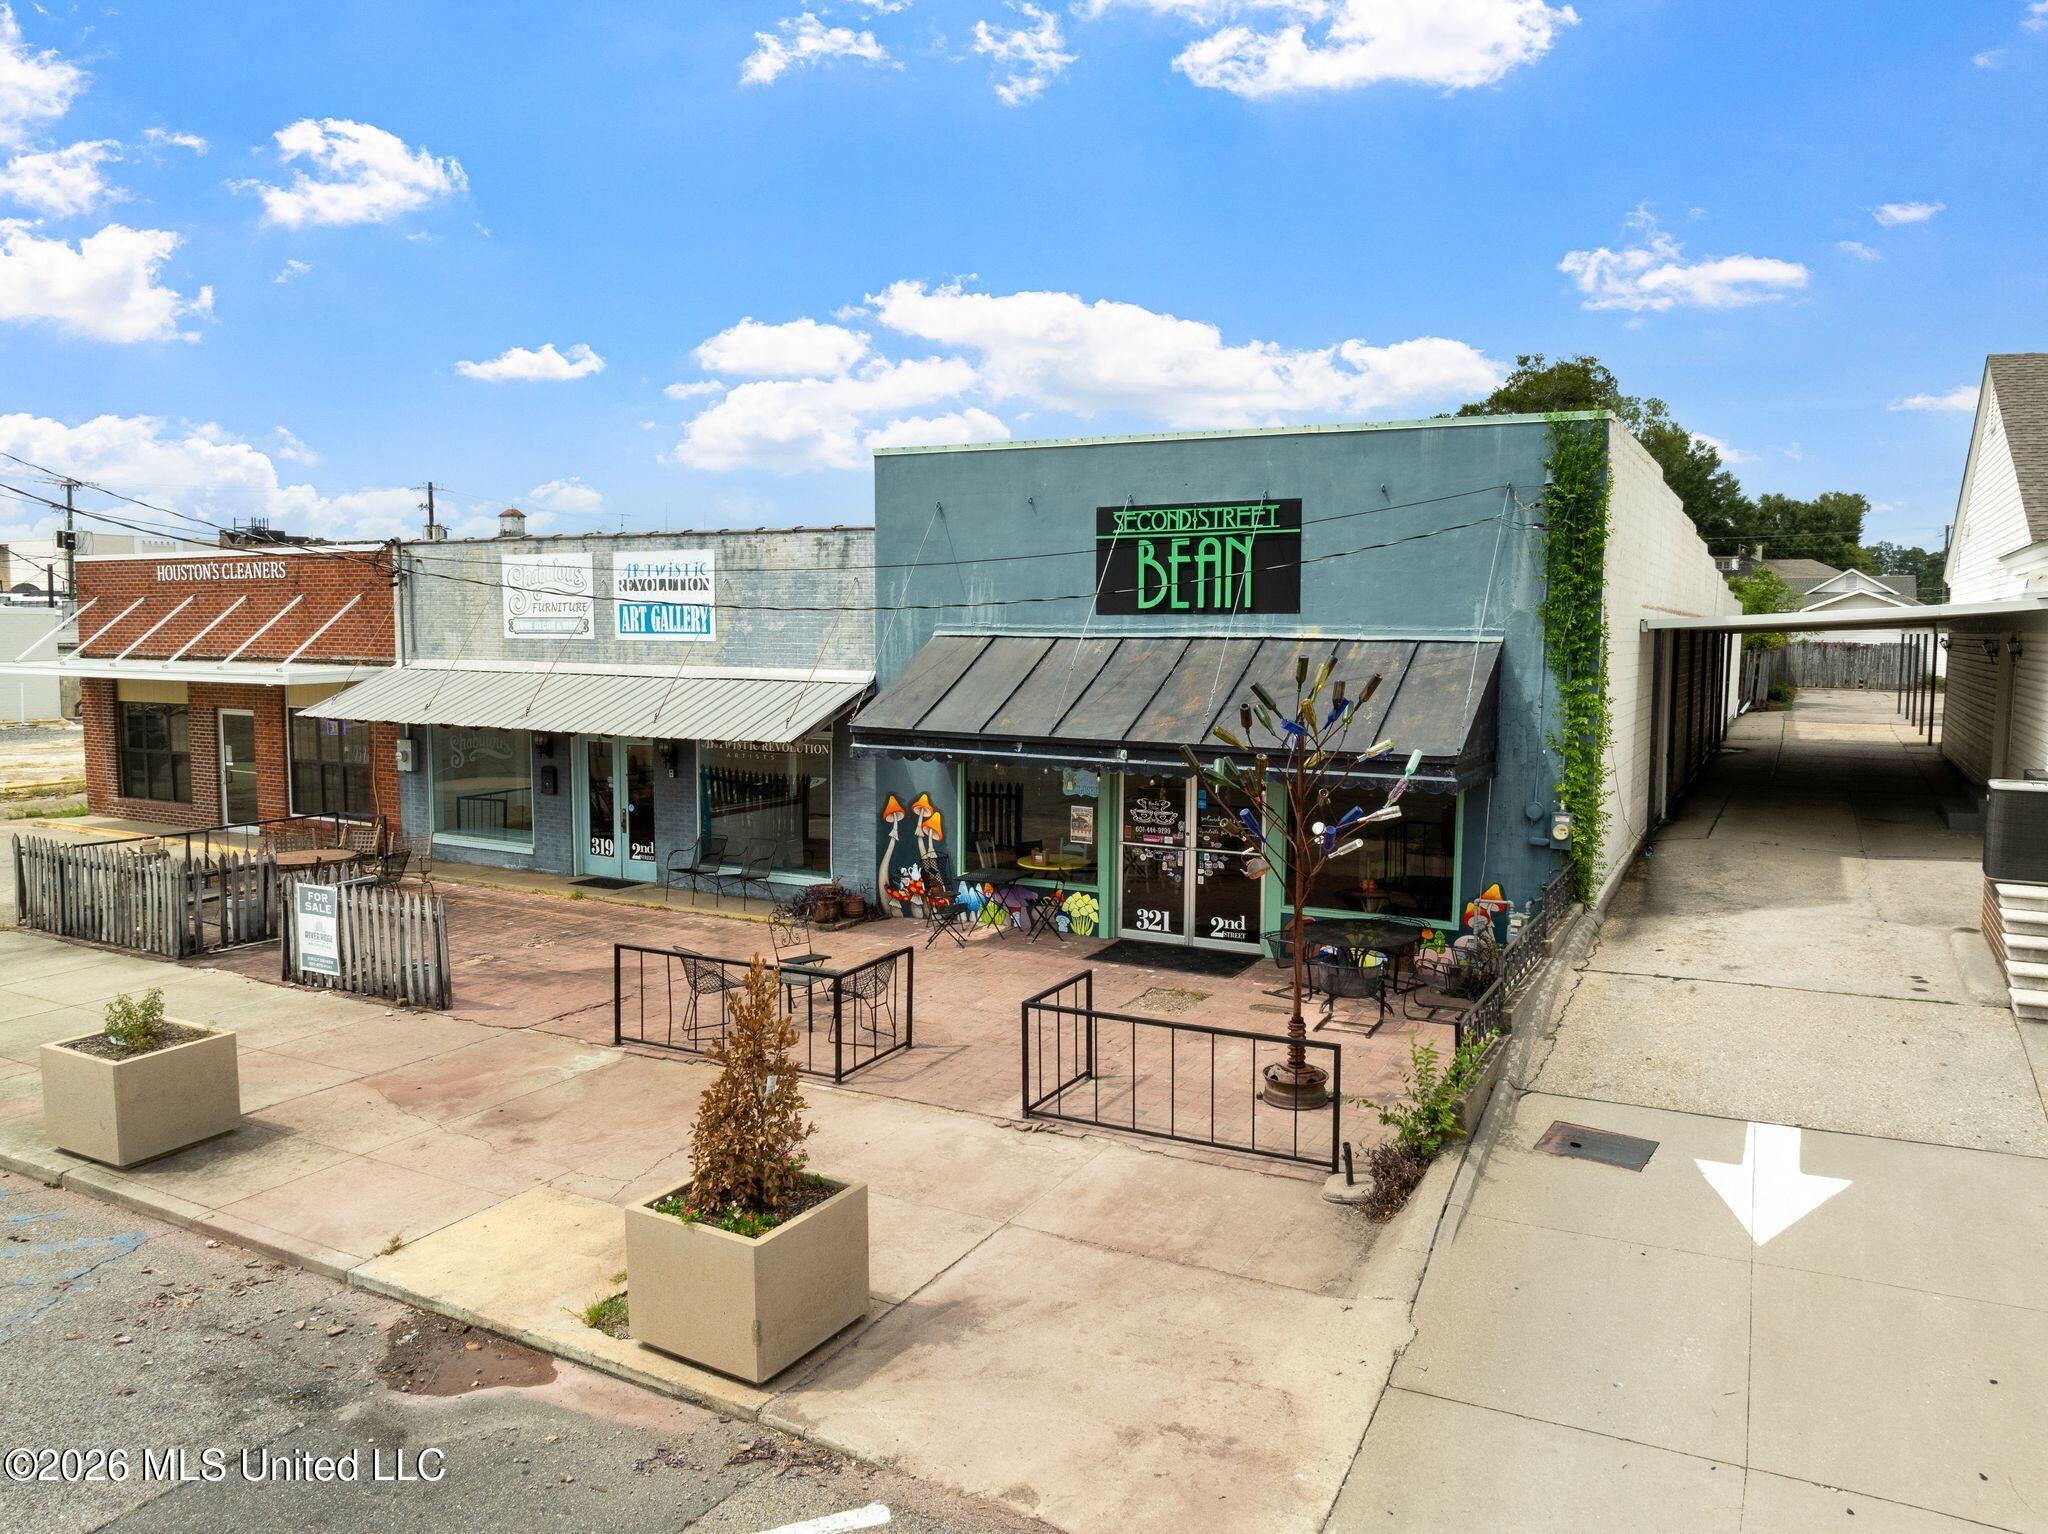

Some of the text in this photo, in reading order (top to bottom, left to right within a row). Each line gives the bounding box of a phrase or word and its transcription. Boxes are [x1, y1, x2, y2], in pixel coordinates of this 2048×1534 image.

[1113, 505, 1280, 533] SECOND STREET
[157, 561, 286, 581] HOUSTON'S CLEANERS
[1137, 536, 1252, 609] BEAN
[618, 578, 710, 592] REVOLUTION
[532, 602, 588, 613] FURNITURE
[621, 605, 709, 633] ART GALLERY
[591, 837, 614, 856] 319
[631, 842, 654, 860] 2nd
[307, 891, 328, 903] FOR
[304, 901, 332, 914] SALE
[1136, 908, 1171, 932] 321
[1210, 915, 1247, 938] 2nd
[1223, 931, 1247, 939] STREET
